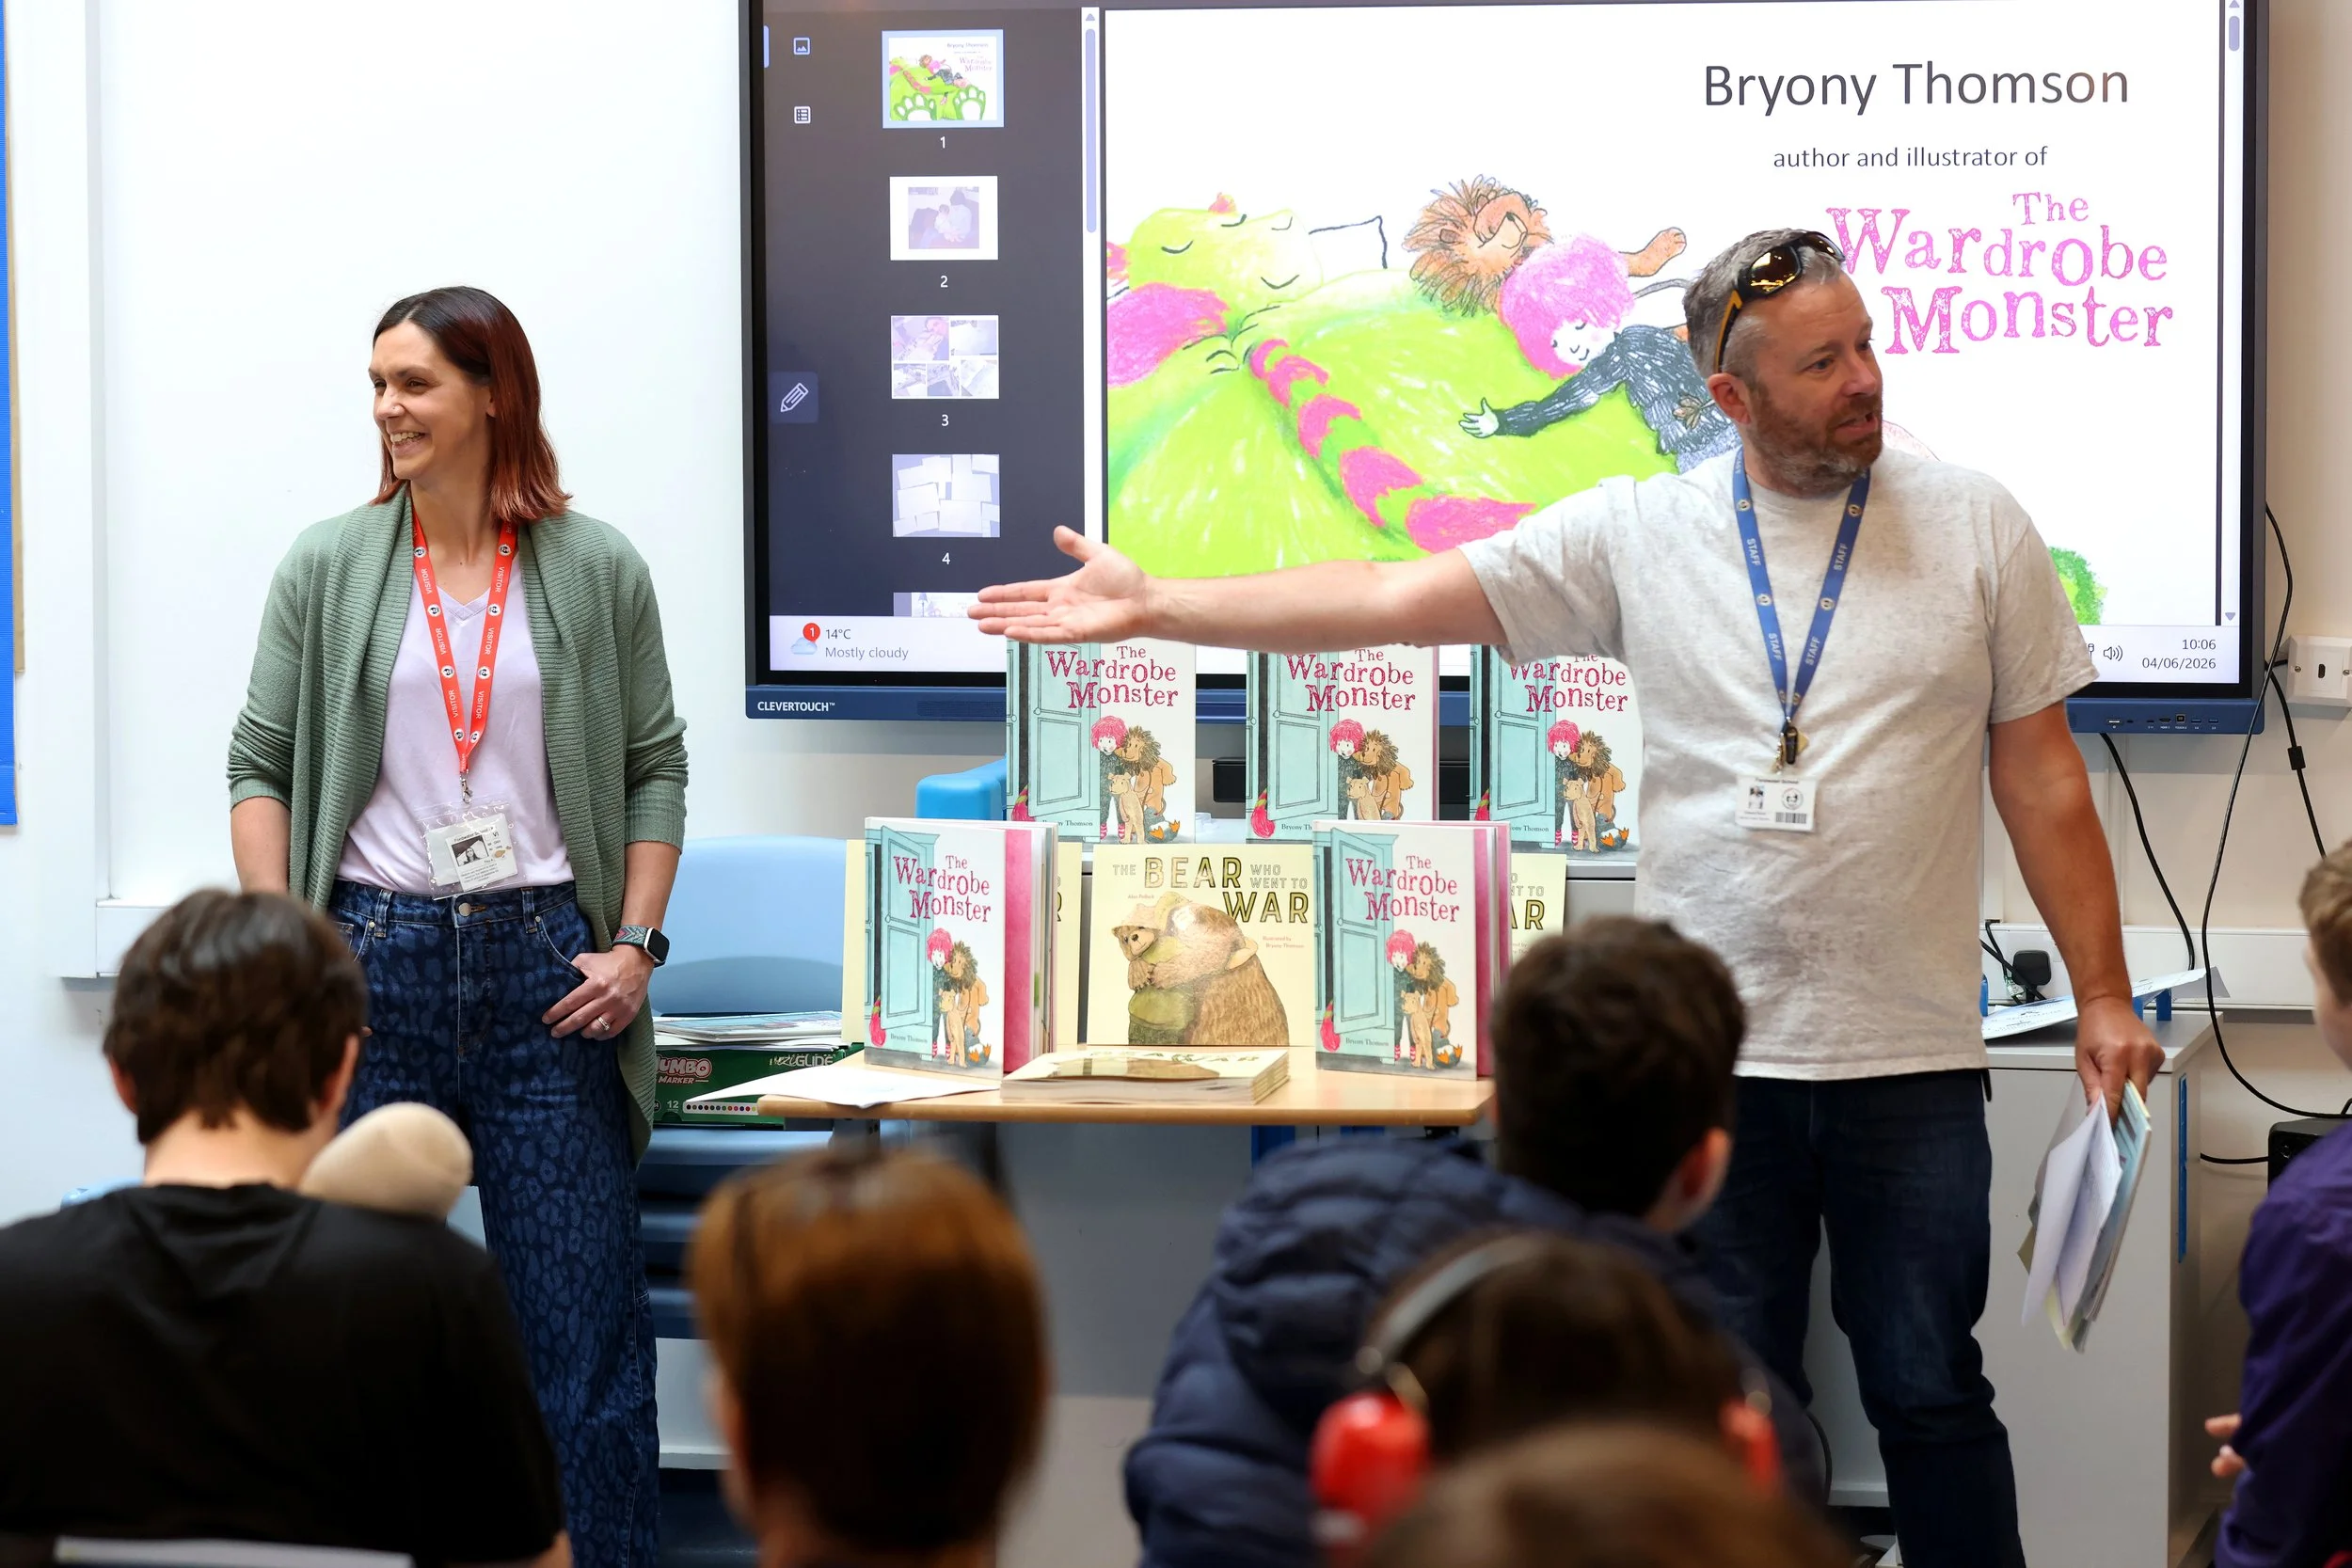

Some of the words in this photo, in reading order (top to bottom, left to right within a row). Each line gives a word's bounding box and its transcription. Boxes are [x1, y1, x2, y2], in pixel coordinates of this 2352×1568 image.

[1705, 65, 1877, 117] Bryony
[1892, 60, 2129, 104] Thomson
[940, 136, 946, 149] 1
[1773, 148, 1850, 168] author
[1856, 147, 1899, 167] and
[1906, 146, 2018, 167] illustrator
[2024, 145, 2048, 166] of
[2012, 191, 2090, 226] The
[1825, 207, 2168, 287] Wardrobe
[940, 276, 948, 288] 2
[1881, 285, 2173, 355] Monster
[941, 414, 949, 427] 3
[942, 553, 951, 565] 4
[1746, 538, 1761, 566] STAFF
[1833, 543, 1849, 571] STAFF
[421, 568, 433, 594] VISITOR
[495, 566, 505, 593] VISITOR
[436, 627, 447, 656] VISITOR
[485, 627, 495, 656] VISITOR
[825, 628, 851, 640] 14°C
[1768, 632, 1783, 661] STAFF
[2182, 639, 2217, 651] 10:06
[825, 647, 866, 660] Mostly
[868, 647, 909, 660] cloudy
[1117, 645, 1147, 659] The
[1355, 648, 1384, 662] The
[1805, 636, 1820, 666] STAFF
[2142, 657, 2217, 670] 04/06/2026
[1044, 650, 1176, 683] Wardrobe
[1284, 654, 1414, 687] Wardrobe
[448, 689, 458, 718] VISITOR
[475, 690, 485, 720] VISITOR
[1066, 681, 1179, 708] Monster
[1305, 684, 1416, 712] Monster
[1524, 684, 1629, 712] Monster
[893, 856, 990, 895] Wardrobe
[946, 854, 968, 869] The
[1112, 863, 1136, 876] THE
[1144, 857, 1242, 888] BEAR
[1250, 864, 1281, 876] WHO
[1406, 855, 1432, 870] The
[1249, 877, 1287, 889] WENT
[1291, 878, 1308, 890] TO
[1345, 858, 1458, 895] Wardrobe
[1528, 886, 1545, 896] TO
[909, 889, 992, 923] Monster
[1222, 891, 1309, 924] WAR
[1364, 891, 1460, 923] Monster
